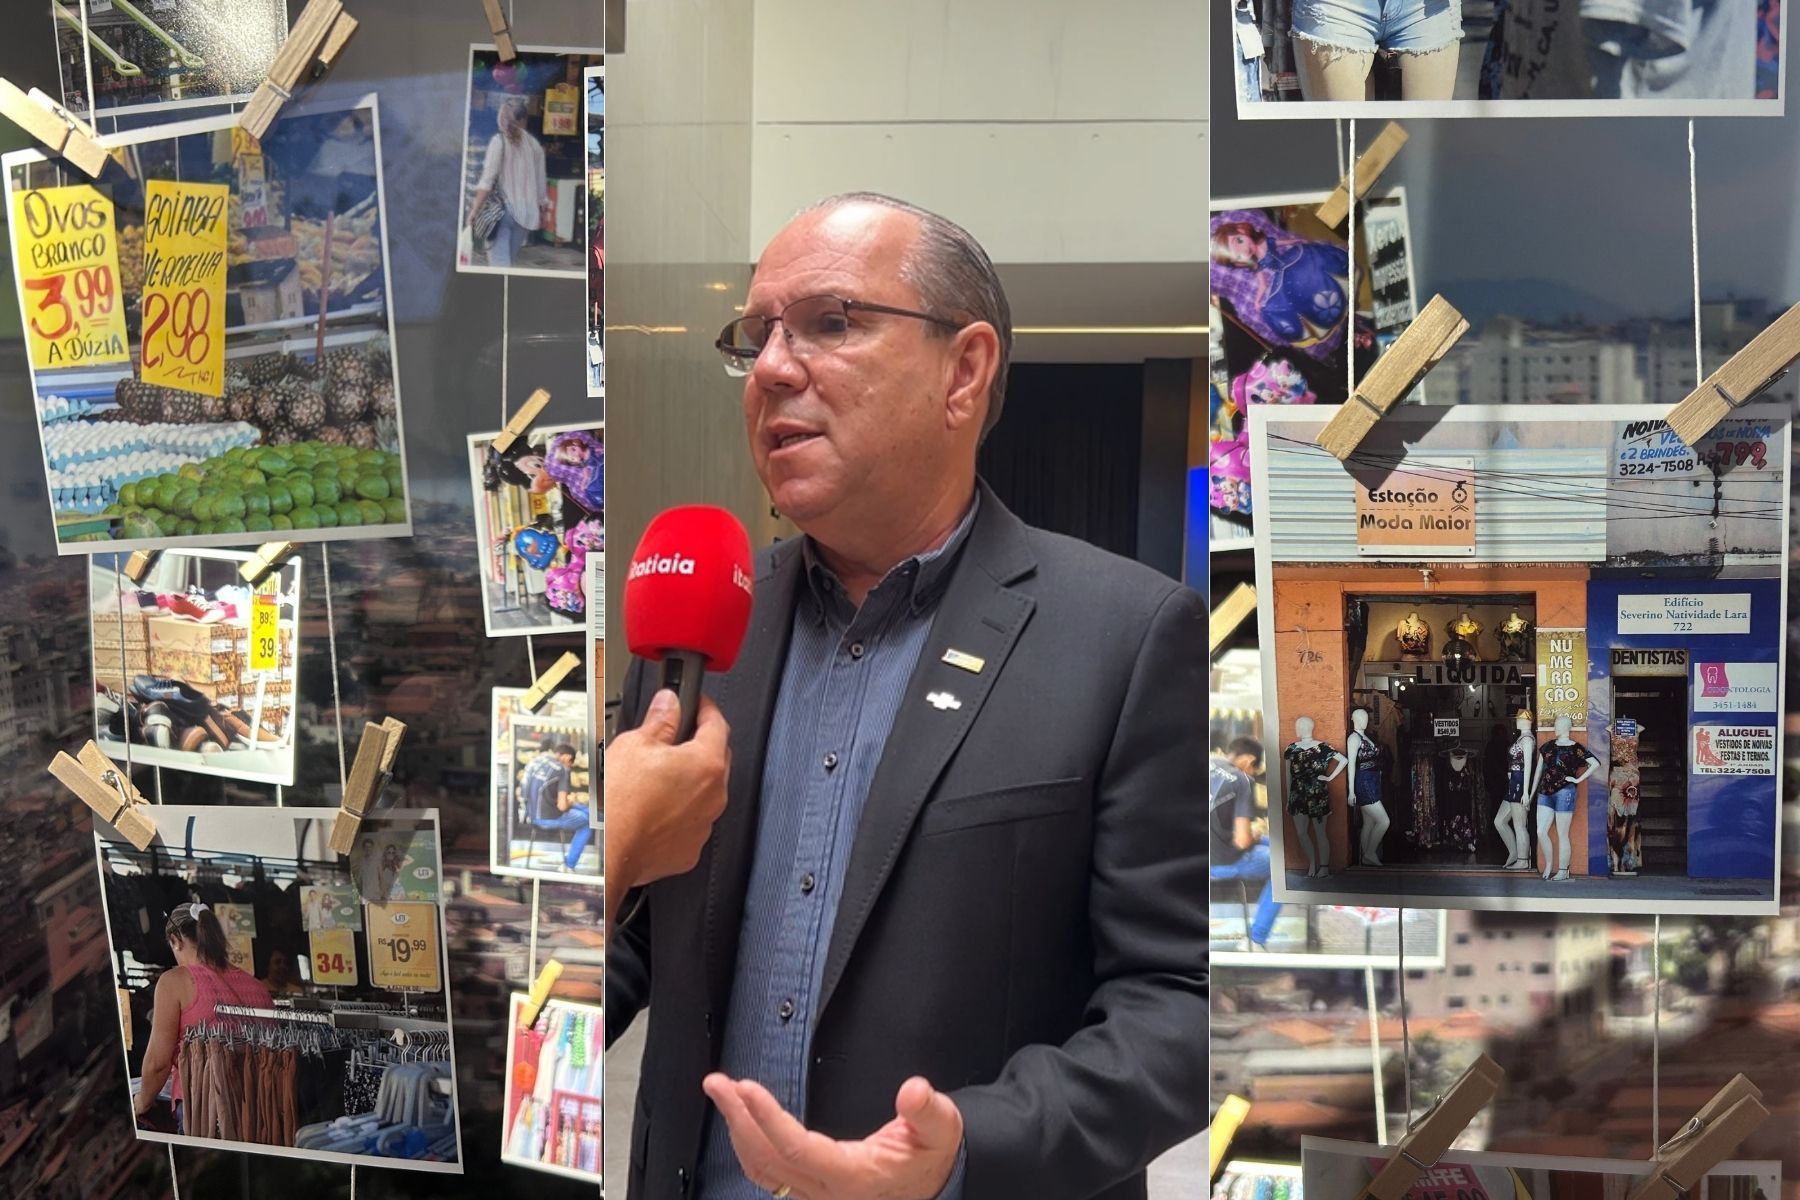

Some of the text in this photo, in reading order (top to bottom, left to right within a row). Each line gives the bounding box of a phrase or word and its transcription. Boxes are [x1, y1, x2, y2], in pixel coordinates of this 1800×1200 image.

[25, 265, 114, 340] 3,99
[142, 288, 210, 369] 2,98
[49, 341, 63, 364] A
[1628, 448, 1637, 460] 2
[1619, 459, 1694, 476] 3224-7508
[1368, 487, 1438, 508] Estação
[1360, 513, 1471, 530] Moda Maior
[1620, 609, 1748, 620] Severino Natividade Lara
[1673, 622, 1693, 631] 722
[1550, 639, 1573, 653] NU
[1550, 655, 1573, 669] ME
[1612, 650, 1686, 665] DENTISTAS
[1416, 665, 1520, 684] LIQUIDA
[1434, 720, 1459, 728] VESTIDOS
[1717, 729, 1772, 737] ALUGUEL
[1715, 740, 1773, 749] VESTIDOS DE NOIVAS
[1720, 751, 1740, 761] FESTAS
[1741, 751, 1745, 761] E
